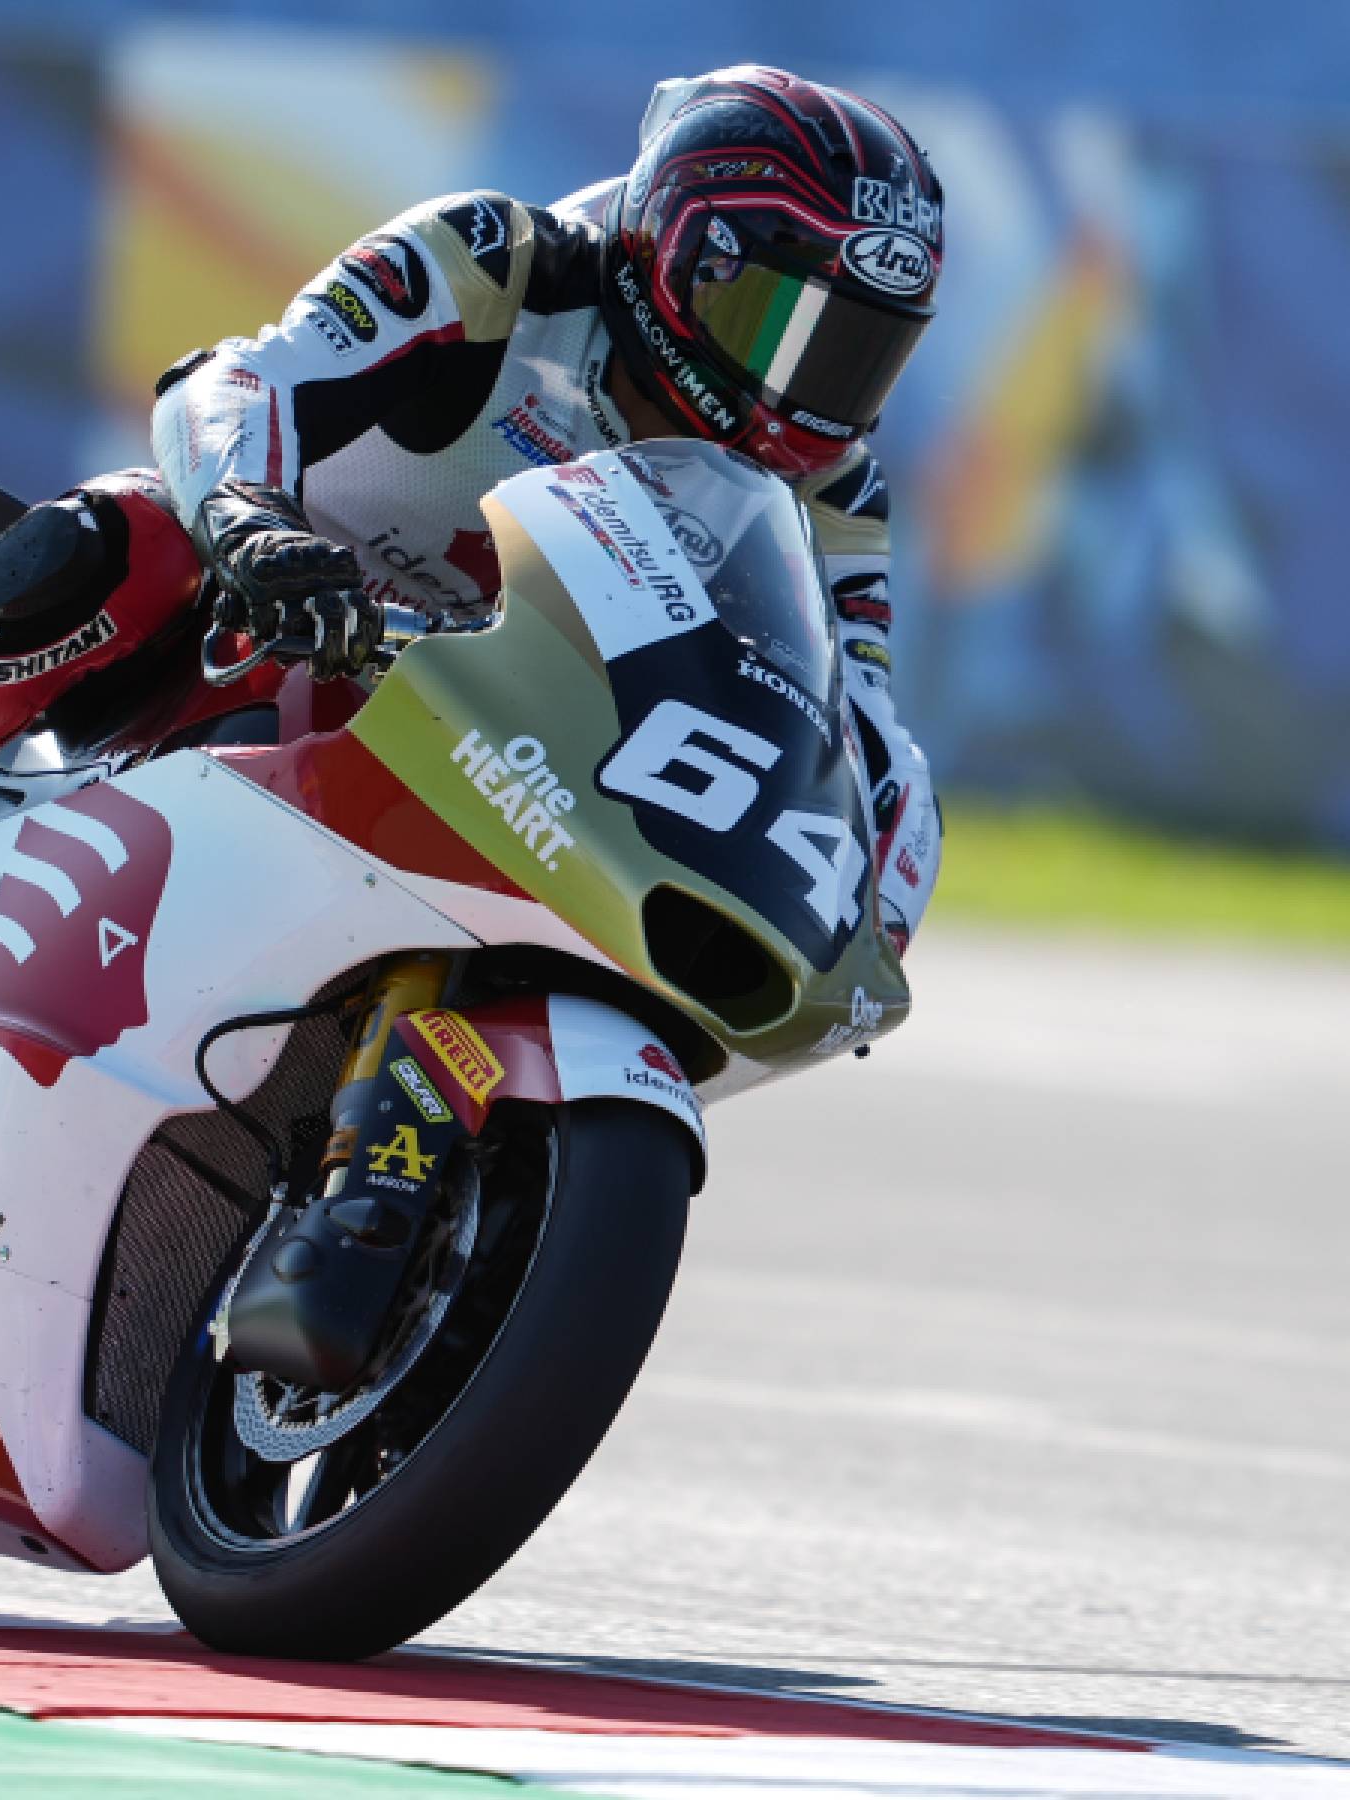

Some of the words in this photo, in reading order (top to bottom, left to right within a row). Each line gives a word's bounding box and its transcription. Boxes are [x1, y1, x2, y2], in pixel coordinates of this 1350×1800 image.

[854, 236, 922, 277] Arai
[632, 302, 679, 368] GLOW
[579, 487, 660, 571] idemitsu
[647, 573, 697, 622] IRG
[737, 652, 832, 748] HONDA
[450, 729, 576, 871] HEART.
[504, 735, 577, 814] One
[599, 698, 868, 936] 64
[421, 1011, 496, 1090] PIRELLI
